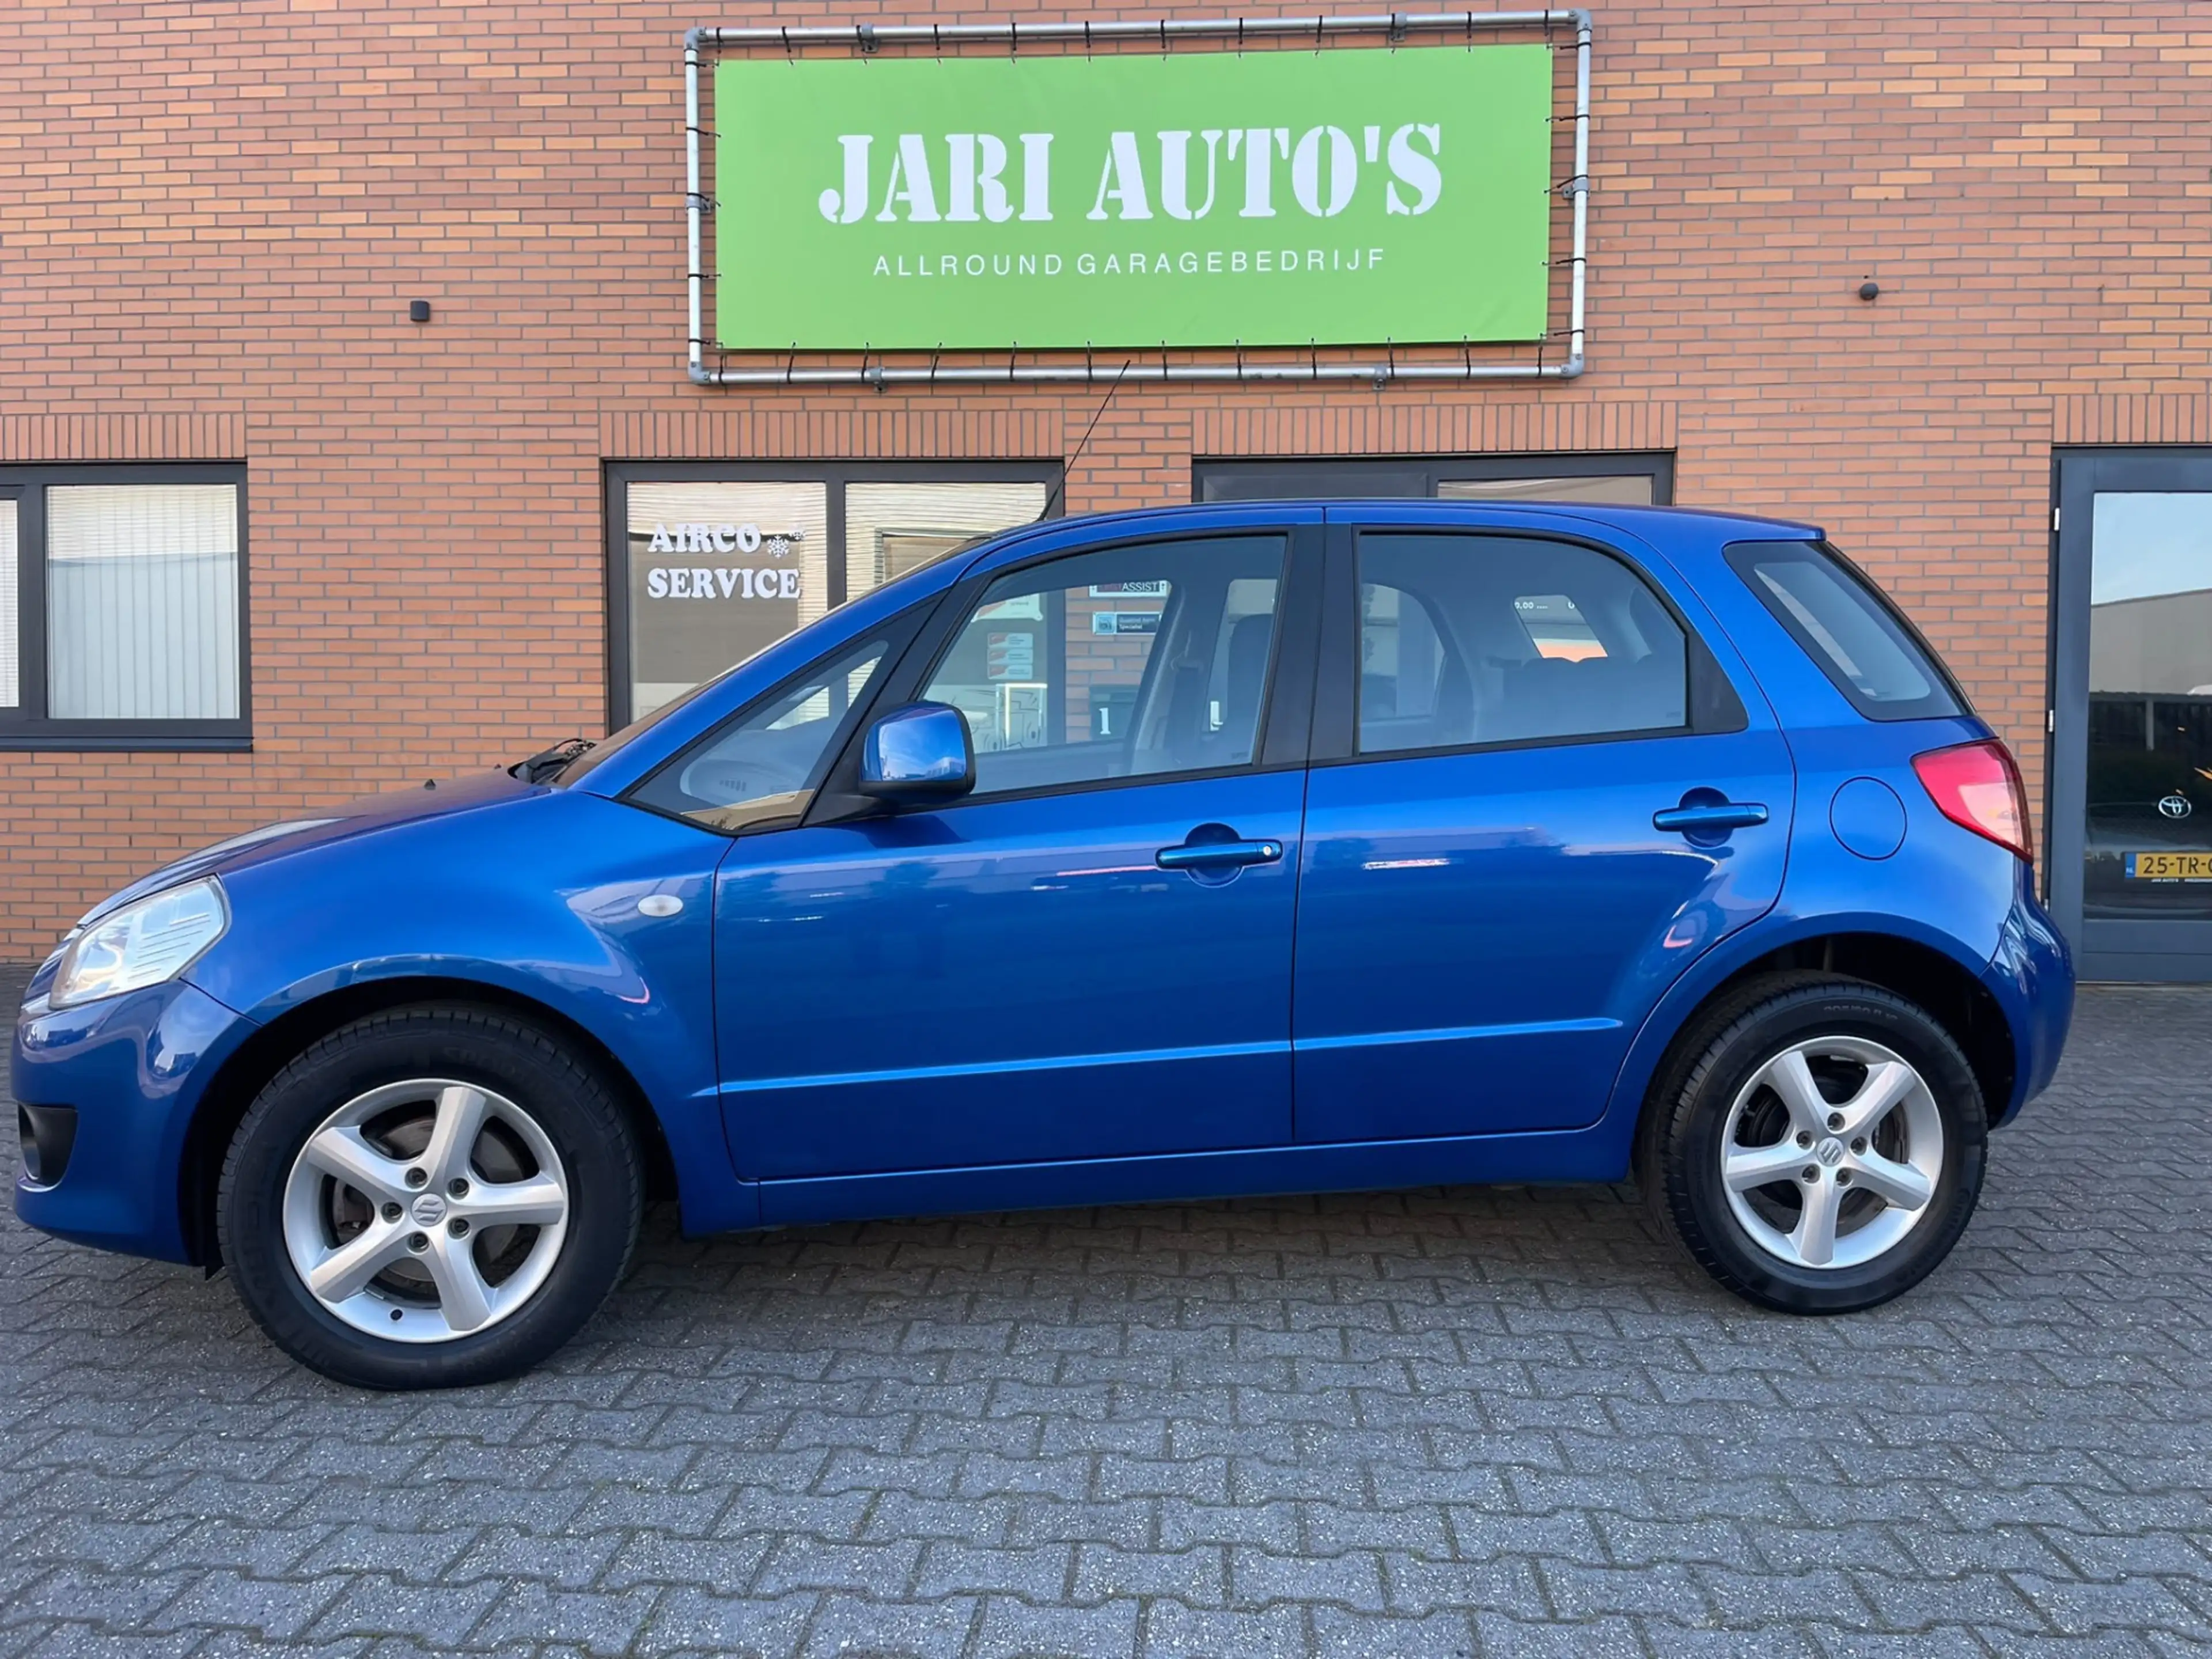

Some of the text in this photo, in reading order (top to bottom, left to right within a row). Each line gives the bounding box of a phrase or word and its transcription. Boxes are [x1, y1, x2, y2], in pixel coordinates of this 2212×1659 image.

[818, 123, 1442, 224] JARI AUTO'S
[874, 248, 1383, 276] ALLROUND GARAGEBEDRIJF
[647, 522, 761, 553] AIRCO
[647, 568, 801, 599] SERVICE
[1122, 582, 1157, 592] ASSIST
